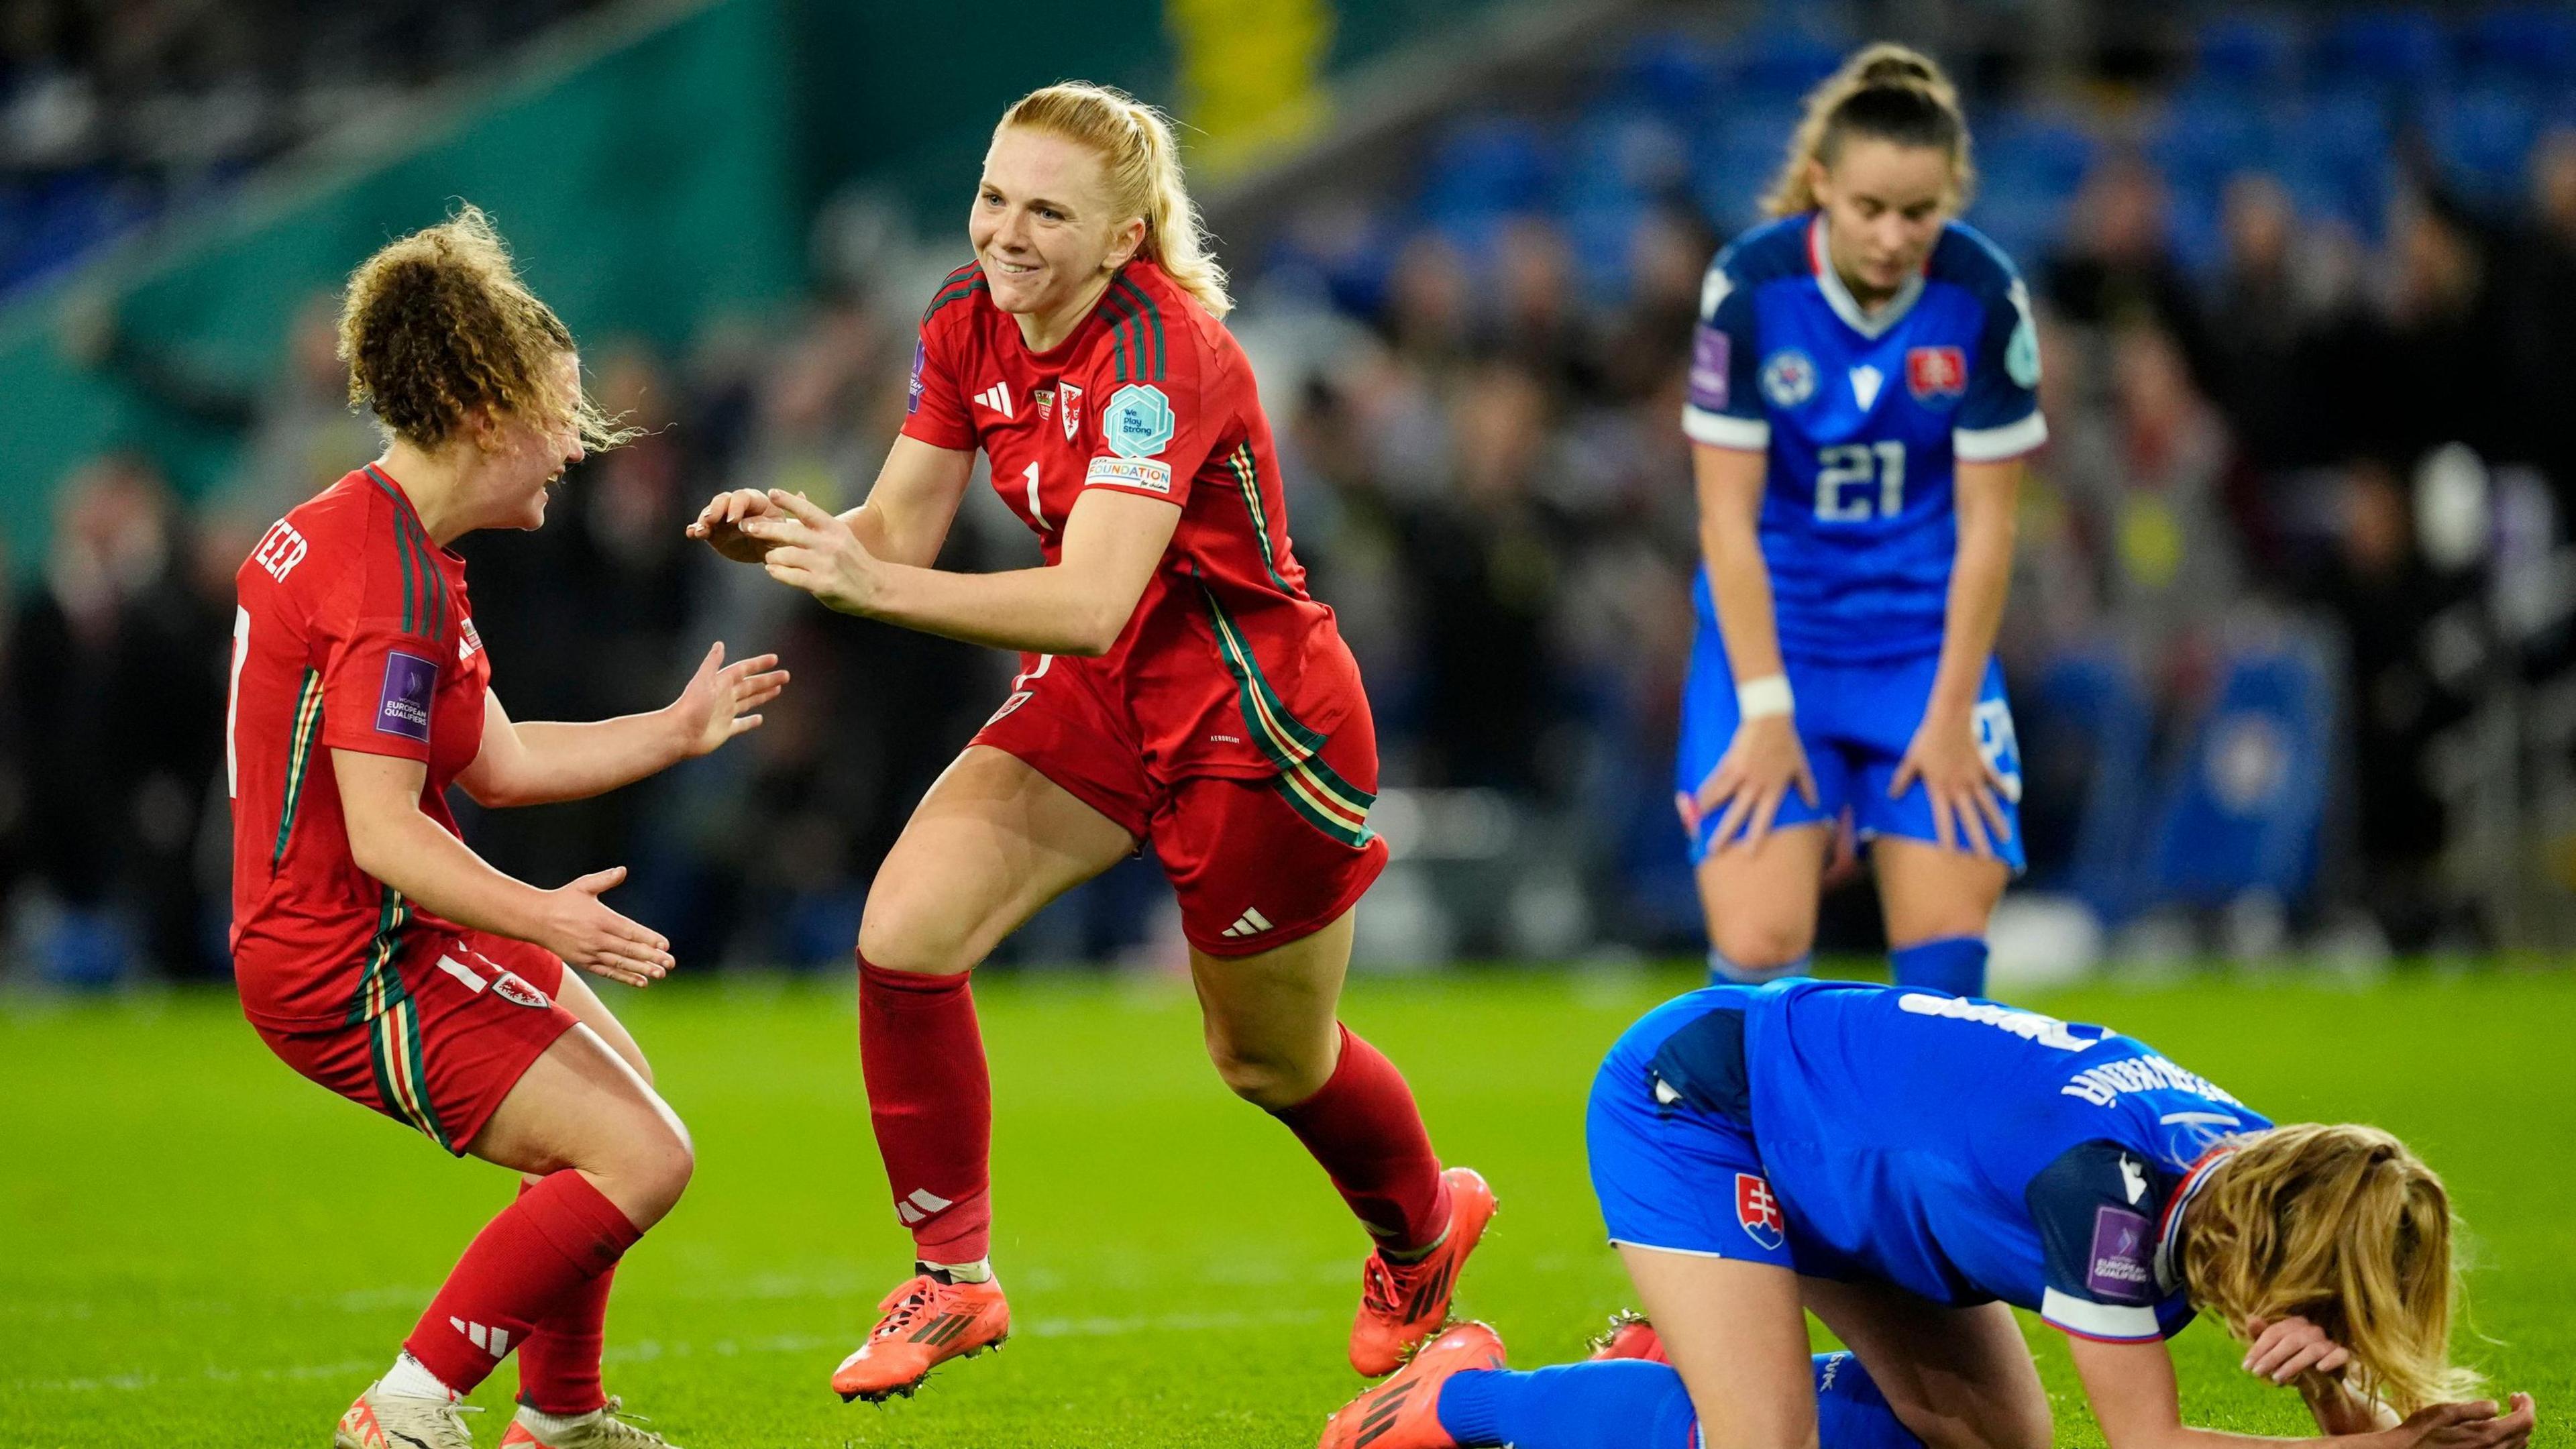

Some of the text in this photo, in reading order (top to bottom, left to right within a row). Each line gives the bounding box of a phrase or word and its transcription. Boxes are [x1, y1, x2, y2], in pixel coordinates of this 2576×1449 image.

[1124, 409, 1137, 417] We
[1124, 417, 1142, 427] Play
[1123, 425, 1152, 437] Strong
[1089, 464, 1169, 483] FOUNDATION
[1815, 440, 1906, 523] 21
[384, 708, 427, 726] QUALIFIERS
[386, 700, 427, 718] EUROPEAN
